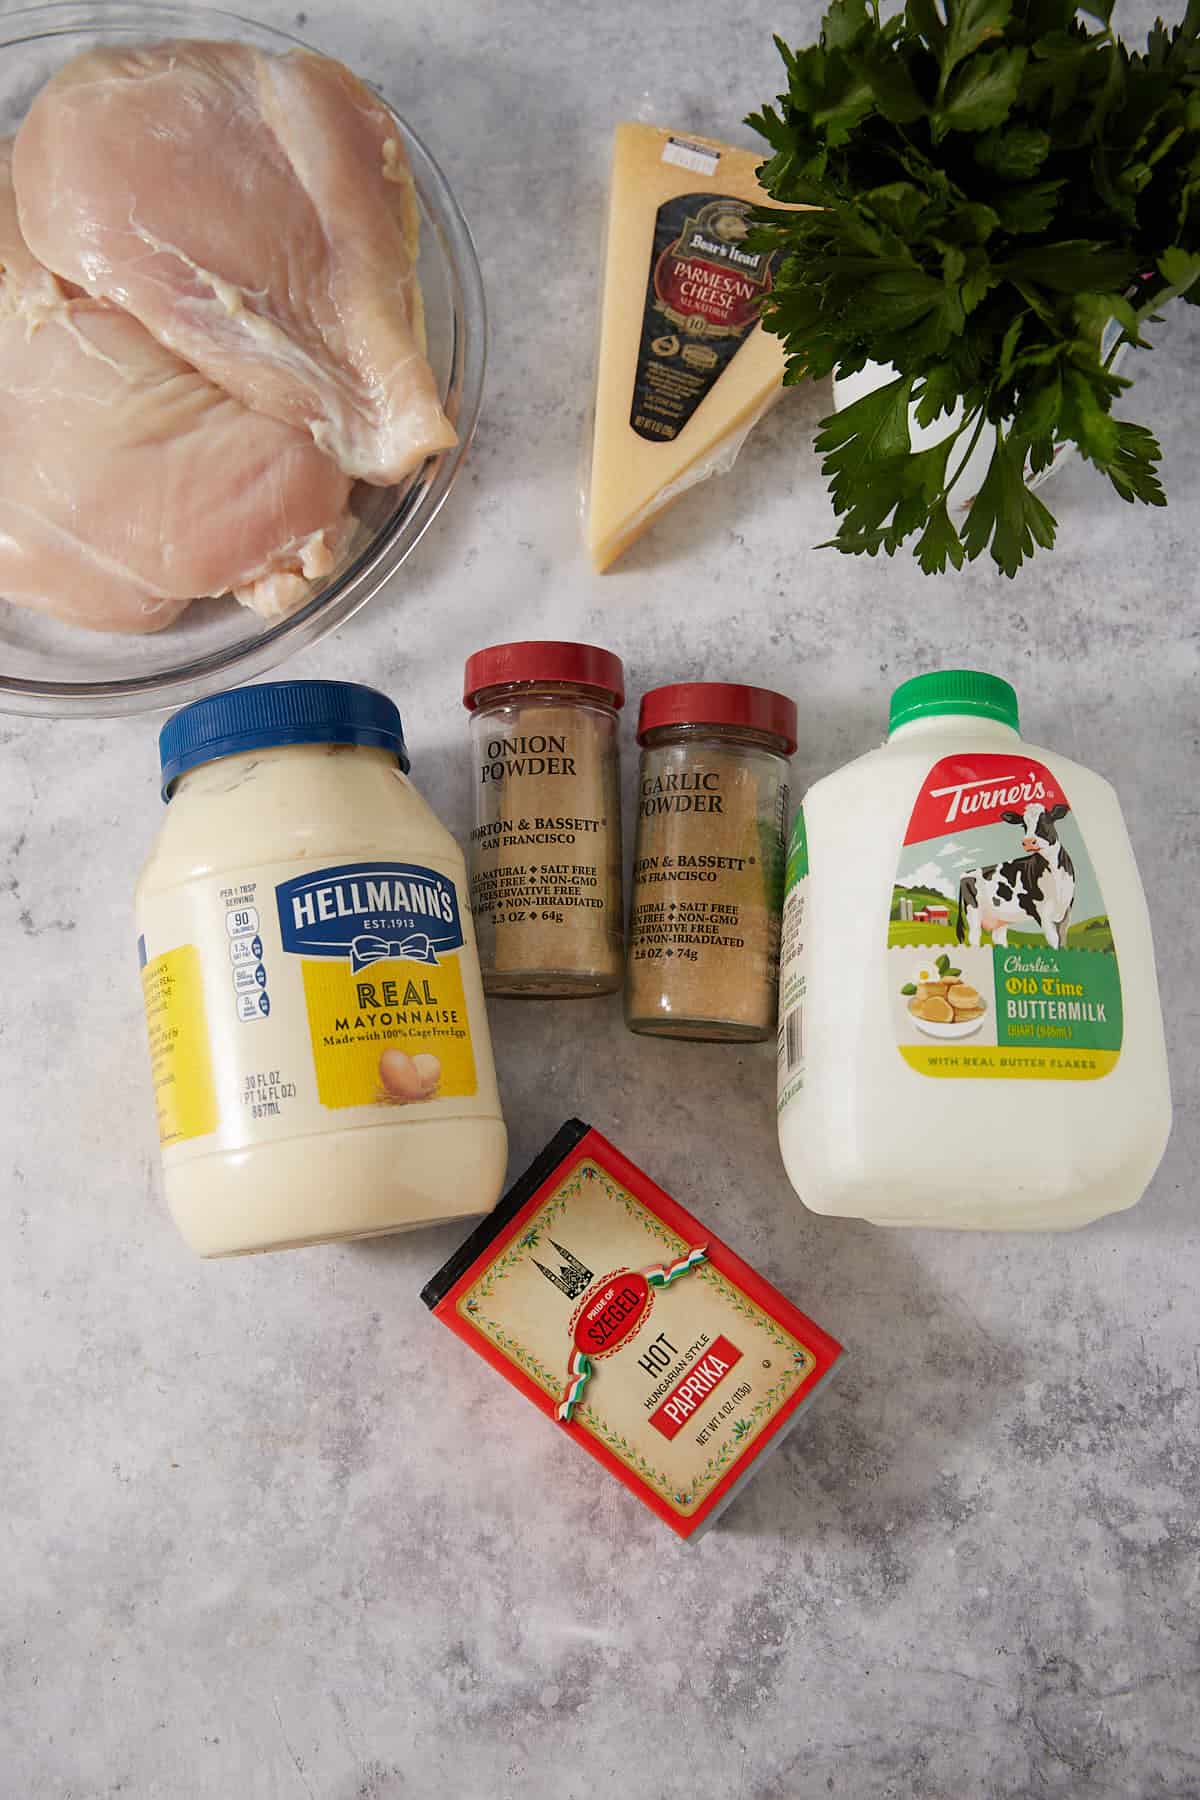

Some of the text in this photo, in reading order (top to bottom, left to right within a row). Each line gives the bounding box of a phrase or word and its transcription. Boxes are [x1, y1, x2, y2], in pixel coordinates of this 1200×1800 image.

[674, 261, 754, 299] PARMESAN
[681, 280, 736, 310] CHEESE
[487, 735, 568, 759] ONION
[480, 757, 576, 784] POWDER
[642, 773, 720, 796] GARLIC
[930, 771, 1046, 823] Turner's
[518, 818, 530, 831] &
[535, 817, 599, 832] BASSETT
[481, 833, 576, 849] SAN FRANCISCO
[482, 866, 526, 880] NATURAL
[541, 865, 569, 874] SALT
[572, 865, 597, 876] FREE
[662, 856, 673, 867] &
[678, 856, 746, 871] BASSETT
[500, 876, 526, 888] FREE
[540, 875, 597, 887] NON-GMO
[648, 872, 717, 882] FRANCISCO
[554, 886, 582, 896] FREE
[292, 880, 454, 929] HELLMANN'S
[506, 897, 604, 909] NON-IRRADIATED
[679, 902, 709, 912] SALT
[711, 904, 739, 914] FREE
[235, 911, 249, 926] 90
[508, 912, 526, 922] OZ
[541, 911, 563, 924] 64g
[678, 913, 739, 925] NON-GMO
[691, 924, 720, 934] FREE
[646, 934, 744, 948] NON-IRRADIATED
[647, 949, 663, 958] OZ
[677, 949, 698, 961] 74g
[1004, 955, 1060, 973] Charlie's
[356, 979, 438, 1009] REAL
[1005, 976, 1083, 996] Old Time
[1007, 999, 1107, 1022] BUTTERMILK
[335, 1011, 458, 1031] MAYONNAISE
[324, 1034, 353, 1046] Made
[357, 1030, 381, 1042] with
[383, 1030, 407, 1041] 100%
[408, 1028, 432, 1040] Cage
[928, 1057, 1097, 1069] WITH REAL BUTTER FLAKES
[257, 1073, 268, 1088] FL
[269, 1071, 281, 1085] OZ
[268, 1087, 280, 1100] FL
[281, 1080, 297, 1098] OZ)
[587, 1288, 615, 1320] PRIDE OF
[588, 1288, 640, 1345] SZEGED
[637, 1332, 679, 1379] HOT
[643, 1333, 711, 1410] HUNGARIAN STYLE
[663, 1354, 729, 1425] PAPRIKA
[695, 1382, 753, 1446] NET WT 4 OZ (113g)
